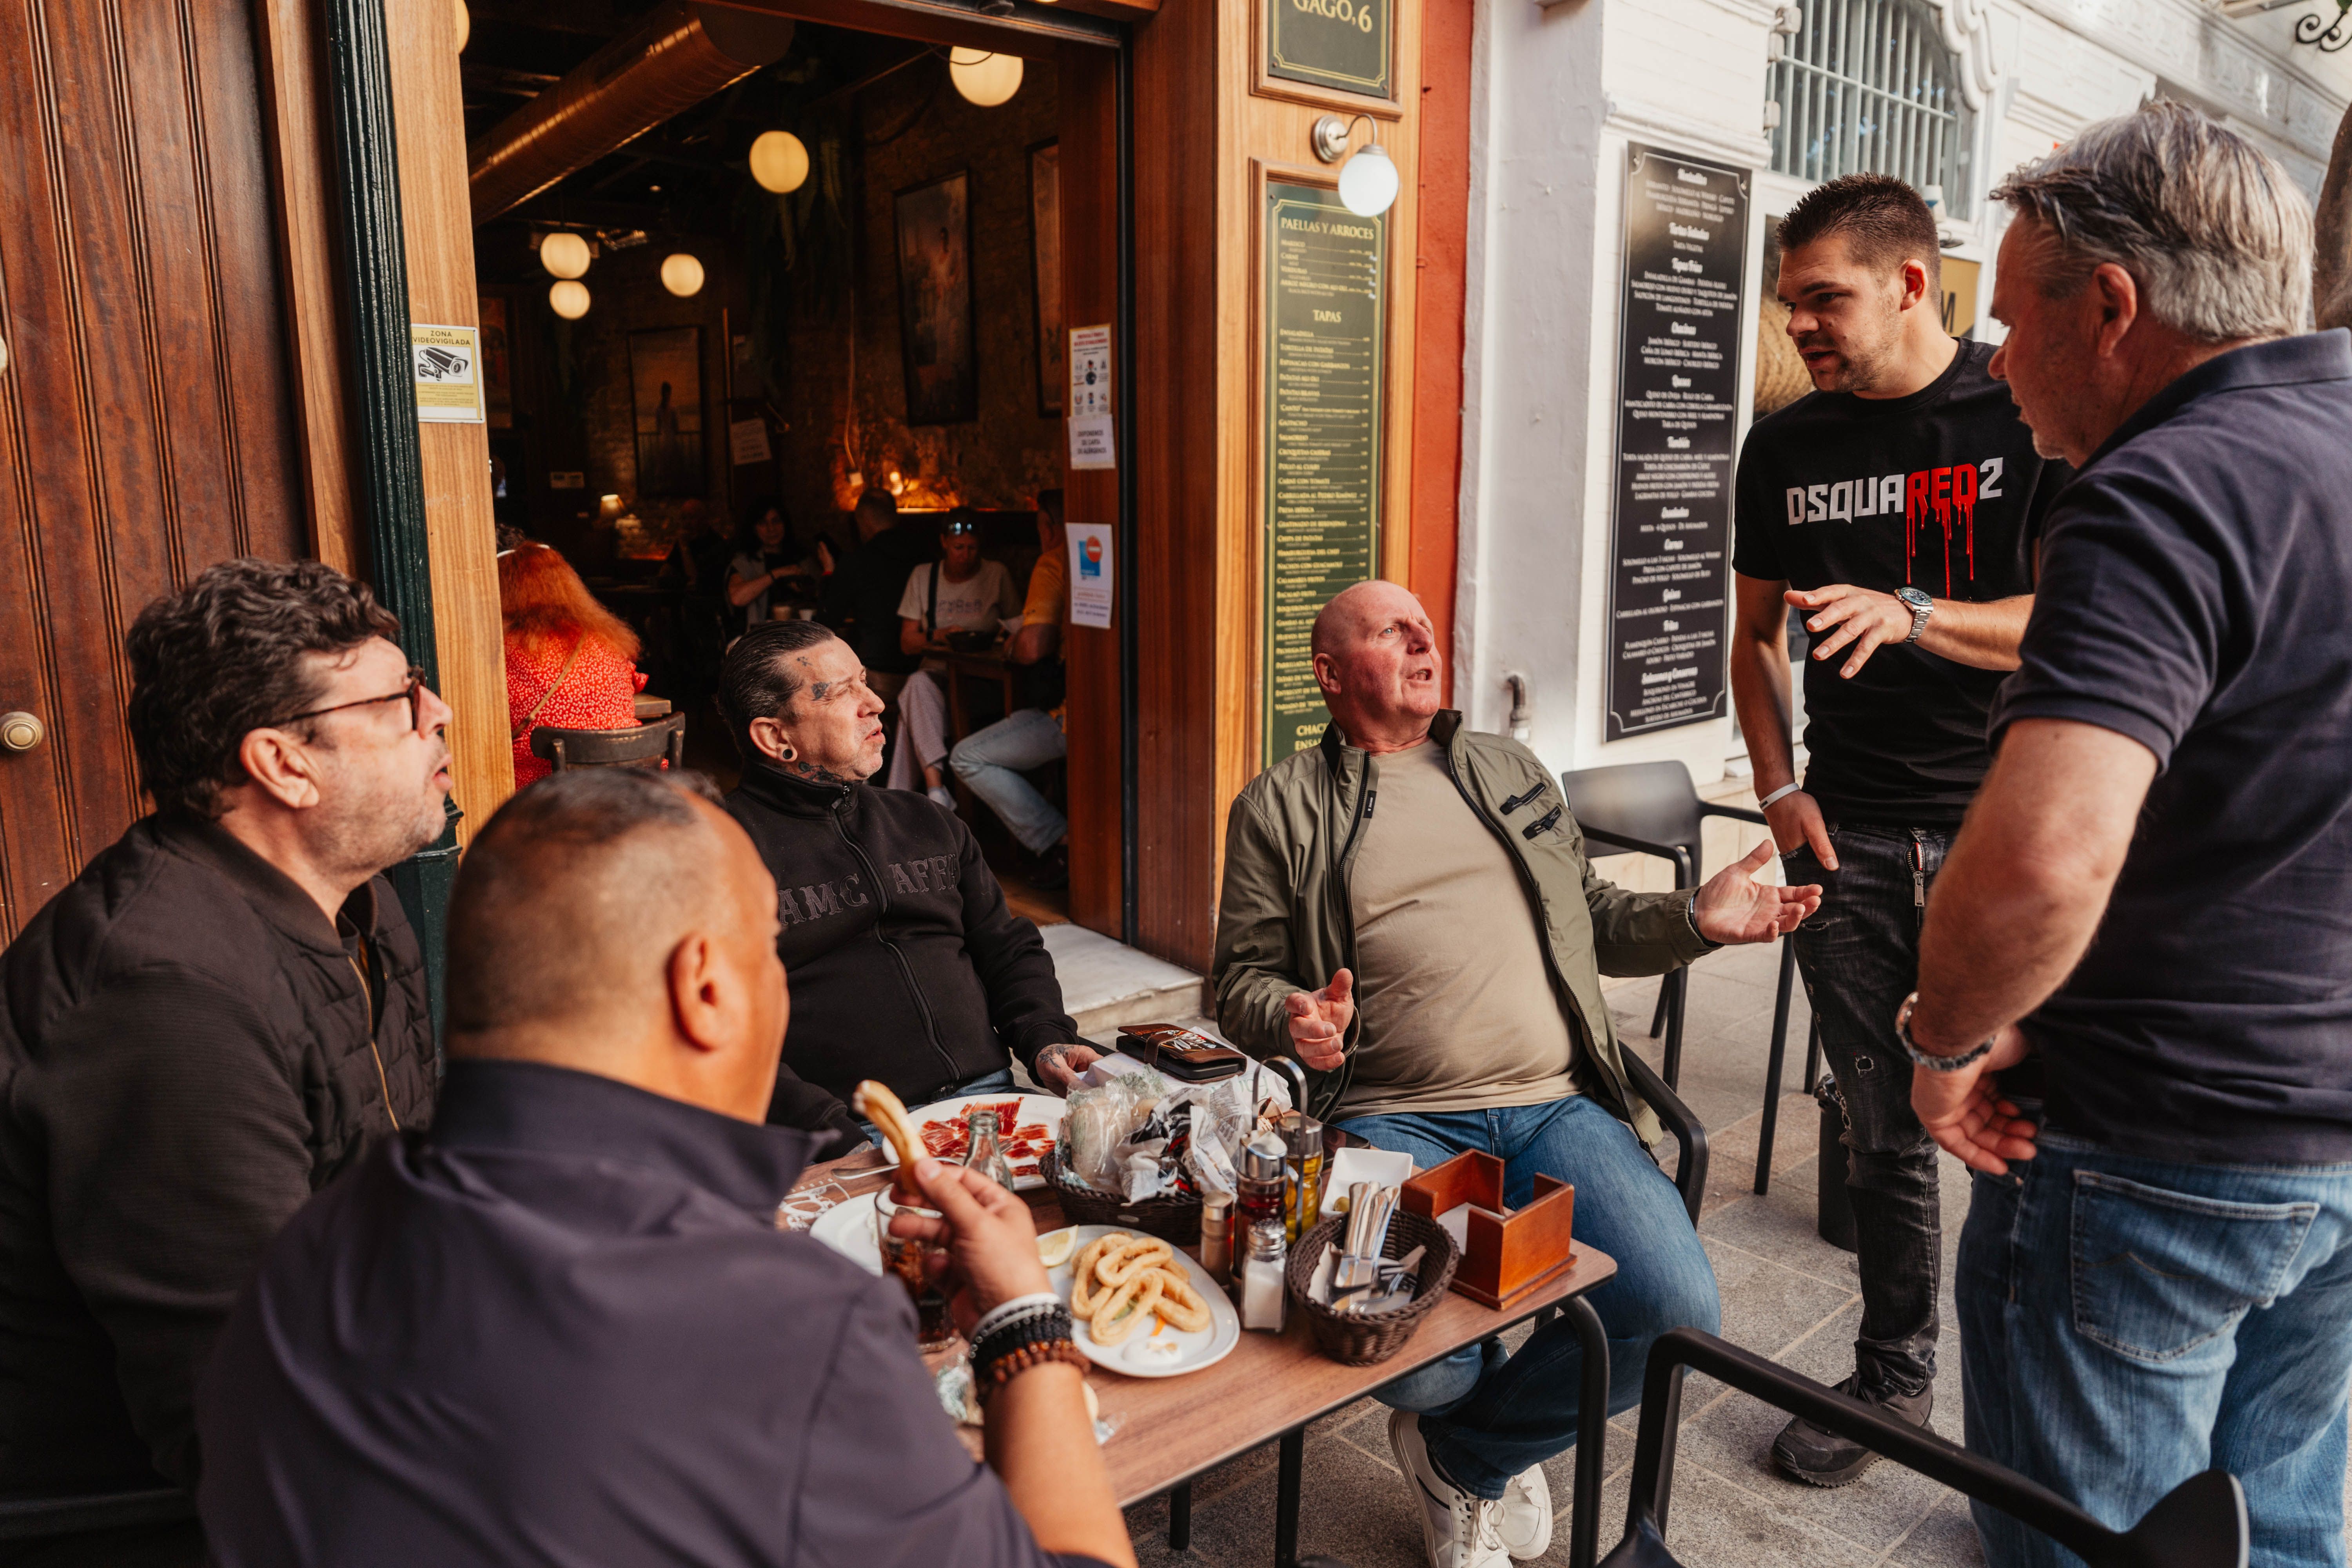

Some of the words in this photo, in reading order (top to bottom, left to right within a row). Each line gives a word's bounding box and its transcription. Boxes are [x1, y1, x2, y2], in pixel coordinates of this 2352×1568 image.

[1281, 216, 1320, 233] PAELLAS
[1321, 221, 1328, 234] Y
[1330, 223, 1374, 240] ARROCES
[1312, 309, 1342, 323] TAPAS
[413, 337, 470, 345] VIDEOVIGILADA
[1786, 457, 2004, 532] DSQUARED2
[778, 873, 869, 926] AMC
